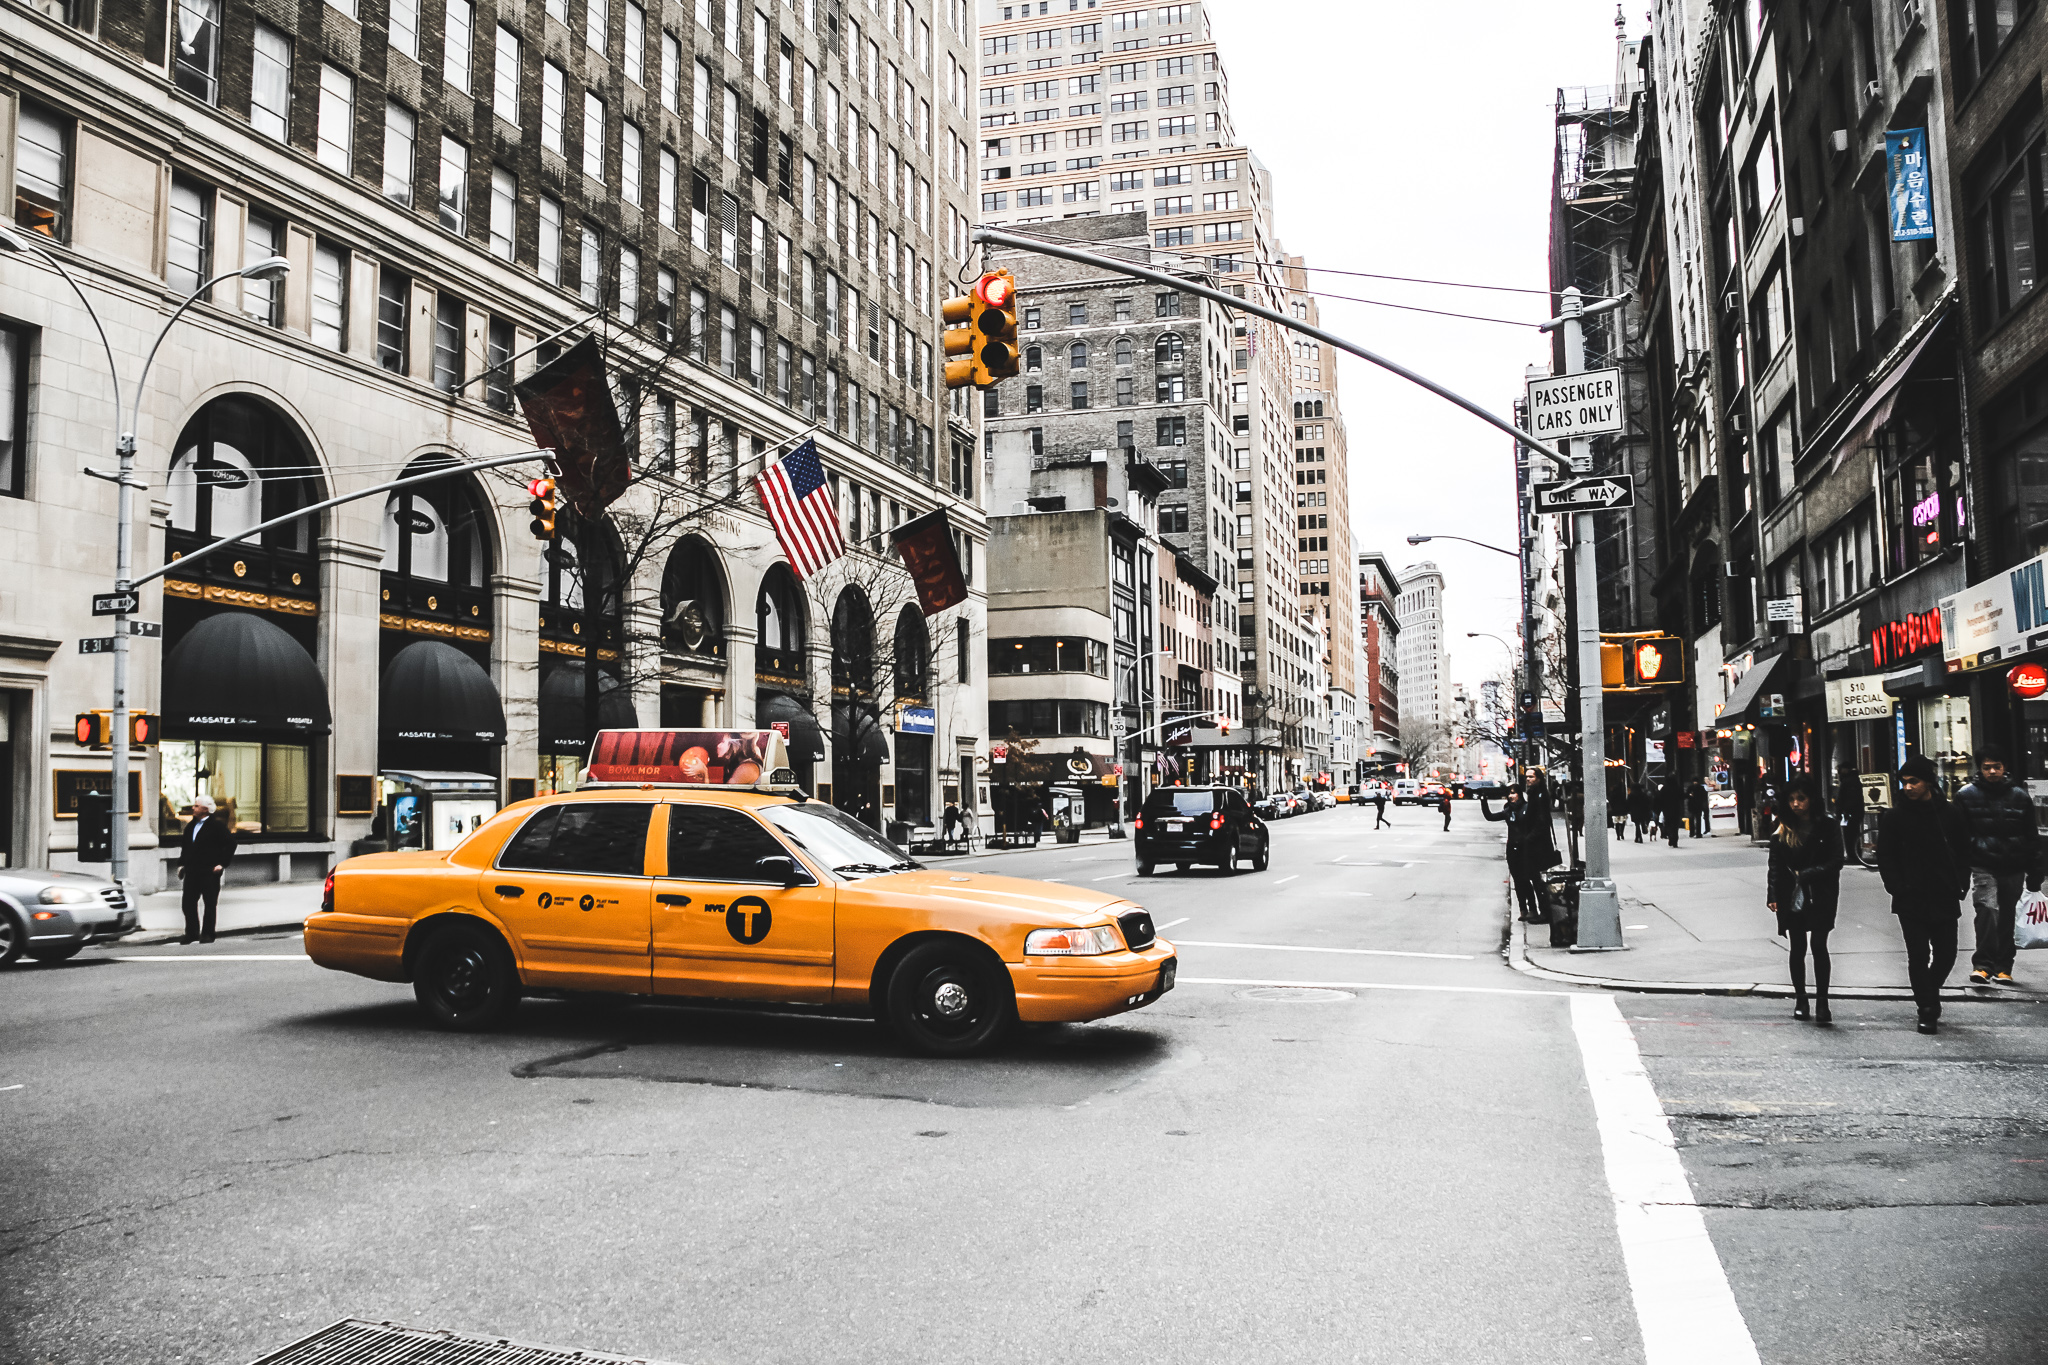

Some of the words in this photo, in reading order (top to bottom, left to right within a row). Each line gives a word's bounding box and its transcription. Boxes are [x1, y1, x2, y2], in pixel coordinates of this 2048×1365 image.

[1535, 380, 1613, 407] PASSENGER
[1537, 410, 1572, 431] CARS
[1579, 404, 1613, 424] ONLY
[1548, 490, 1577, 503] ONE
[1588, 487, 1617, 500] WAY
[99, 599, 112, 609] ONE
[118, 599, 133, 608] WAY
[137, 622, 144, 635] 5
[83, 640, 88, 652] E
[93, 640, 101, 652] 31
[2013, 674, 2046, 687] Leica
[1850, 683, 1866, 692] $10
[1844, 694, 1883, 705] SPECIAL
[1845, 706, 1887, 717] READING
[188, 716, 236, 724] KASSATEX
[608, 765, 661, 775] BOWLMOR
[704, 904, 726, 913] NYC
[737, 905, 762, 938] T
